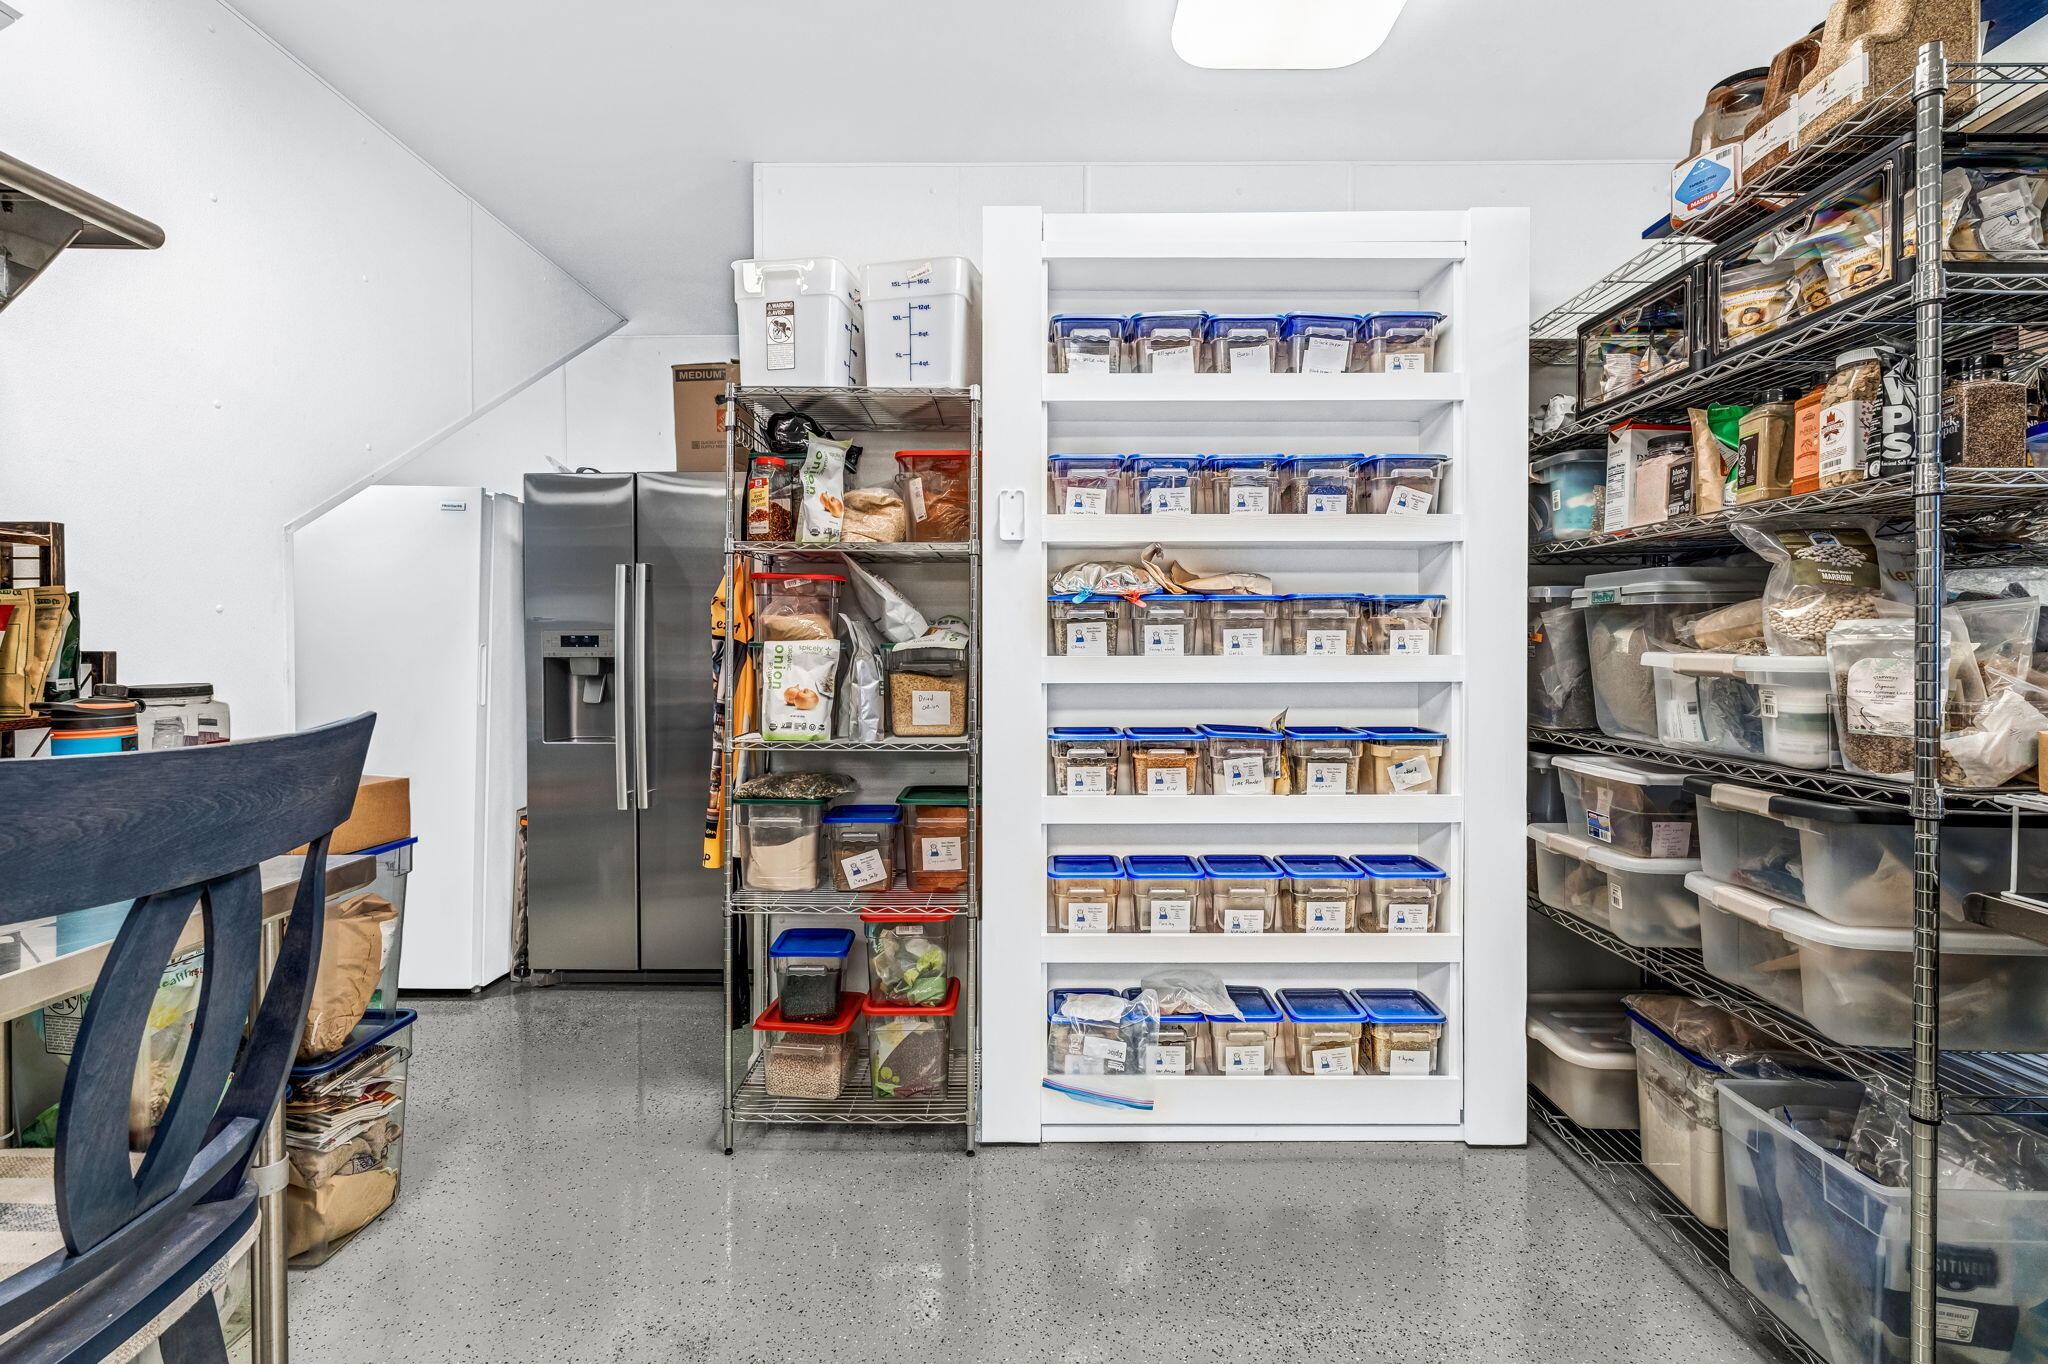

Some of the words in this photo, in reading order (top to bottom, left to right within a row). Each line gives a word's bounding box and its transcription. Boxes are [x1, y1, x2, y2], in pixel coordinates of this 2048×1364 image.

[679, 370, 722, 379] MEDIUM
[1822, 573, 1852, 581] MARROW
[772, 645, 785, 690] onion
